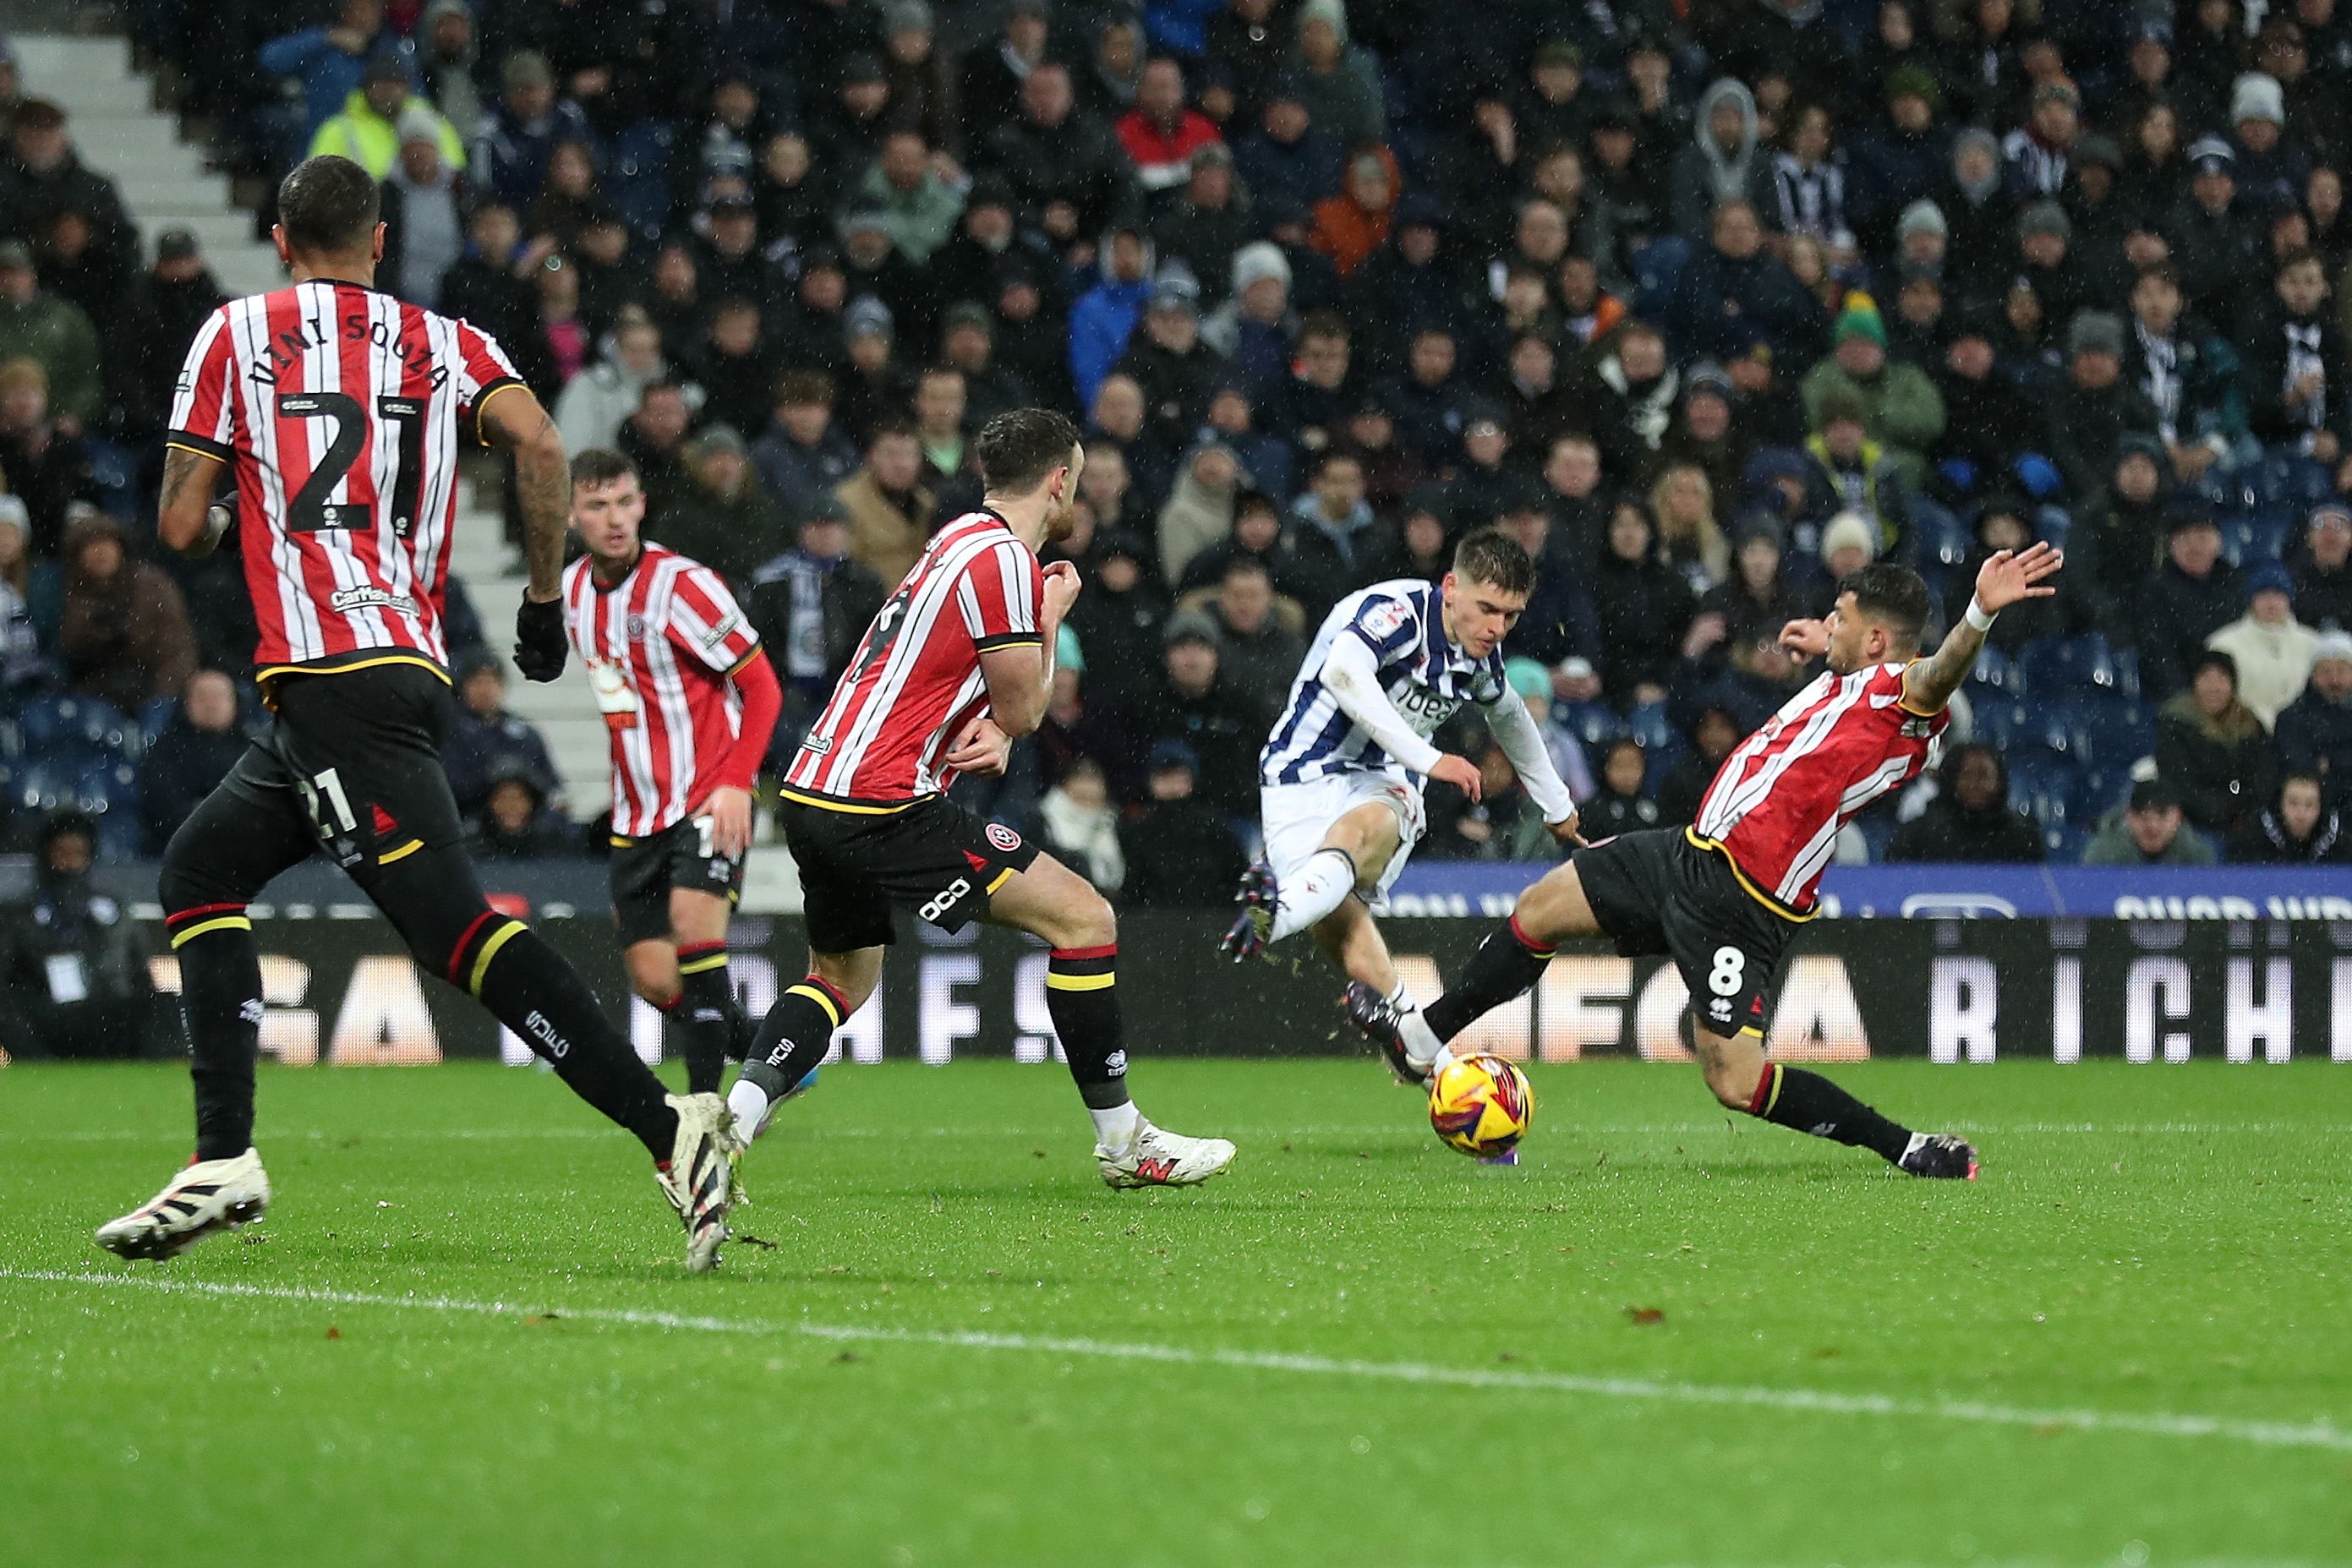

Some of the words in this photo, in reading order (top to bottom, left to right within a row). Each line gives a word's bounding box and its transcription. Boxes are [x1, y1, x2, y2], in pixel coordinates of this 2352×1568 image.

[248, 317, 328, 386] VINI
[346, 314, 451, 393] SOUZA
[277, 392, 427, 539] 21
[297, 767, 358, 839] 21
[919, 877, 971, 921] OCO
[1708, 945, 1746, 997] 8
